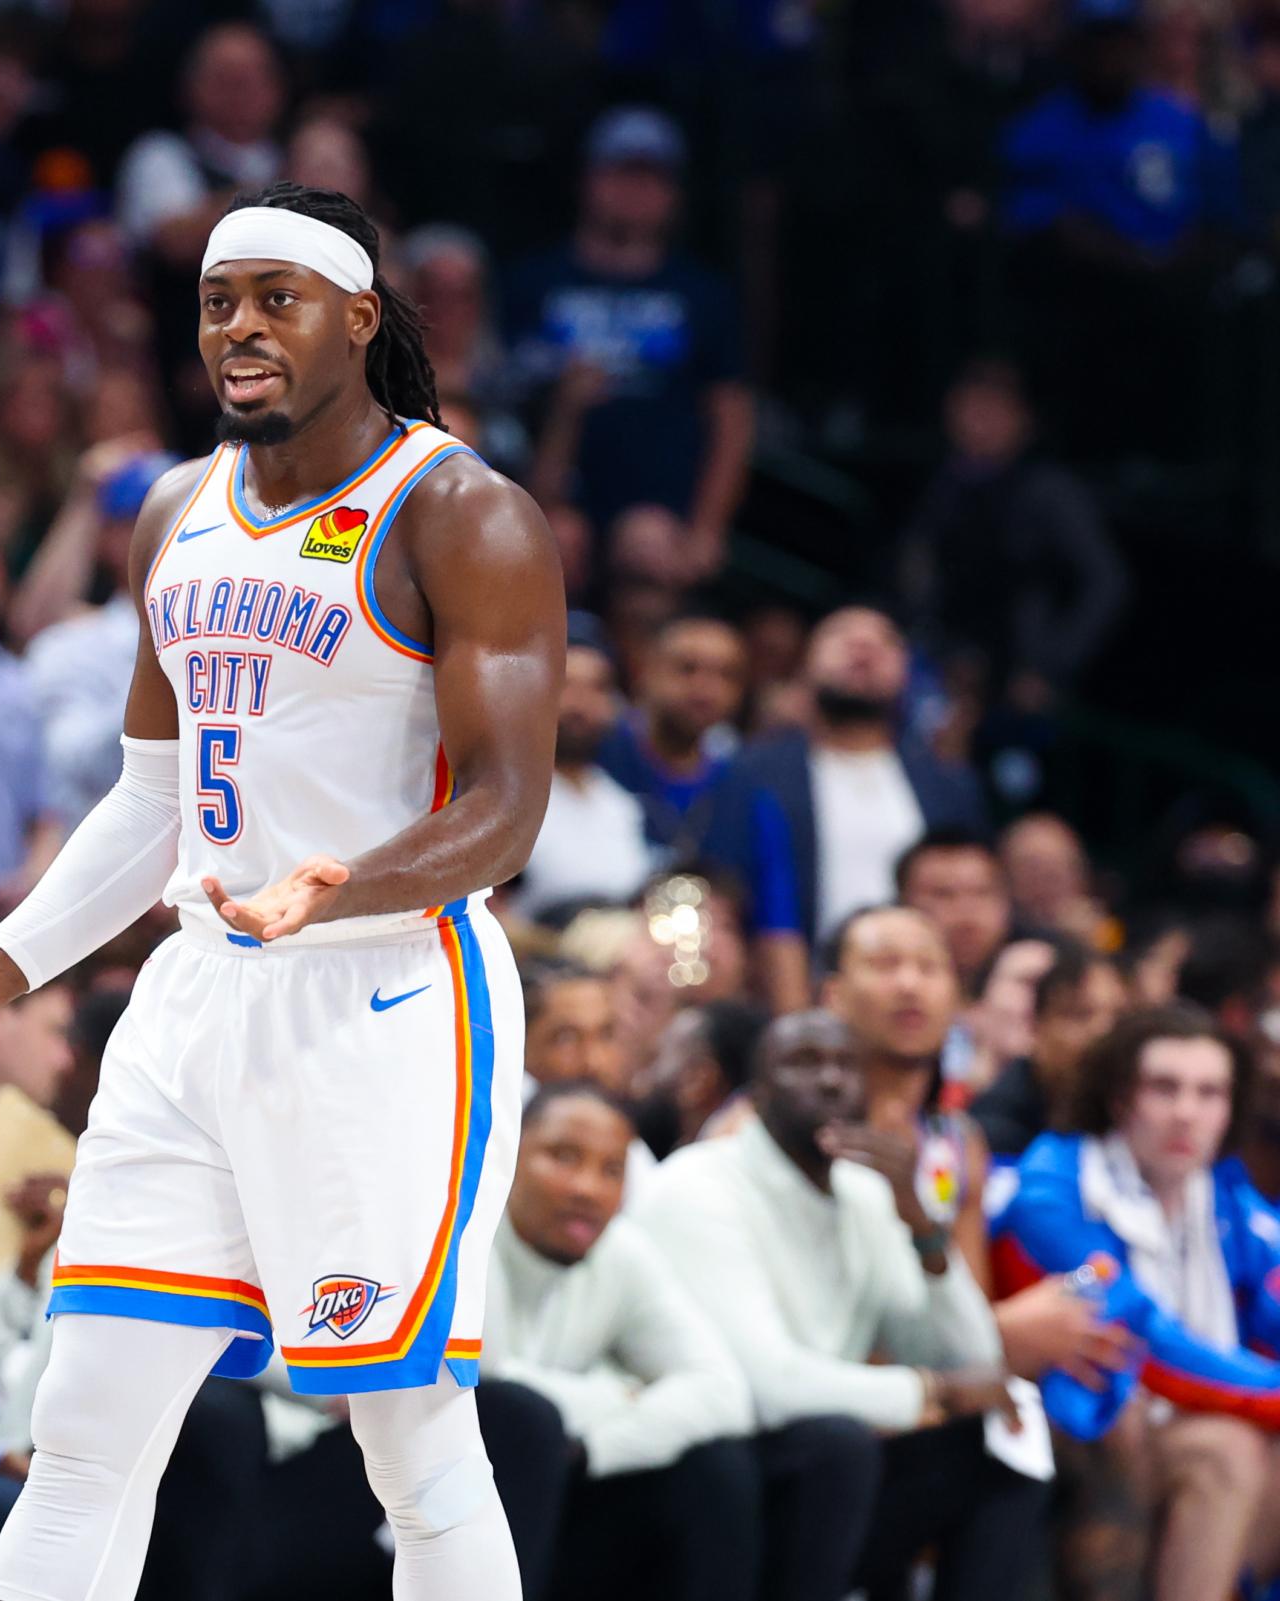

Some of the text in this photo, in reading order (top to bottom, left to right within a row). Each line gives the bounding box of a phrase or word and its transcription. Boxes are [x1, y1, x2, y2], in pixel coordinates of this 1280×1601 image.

[304, 537, 352, 559] Love's
[186, 650, 272, 716] CITY
[197, 723, 243, 846] 5
[310, 1285, 364, 1328] OKC
